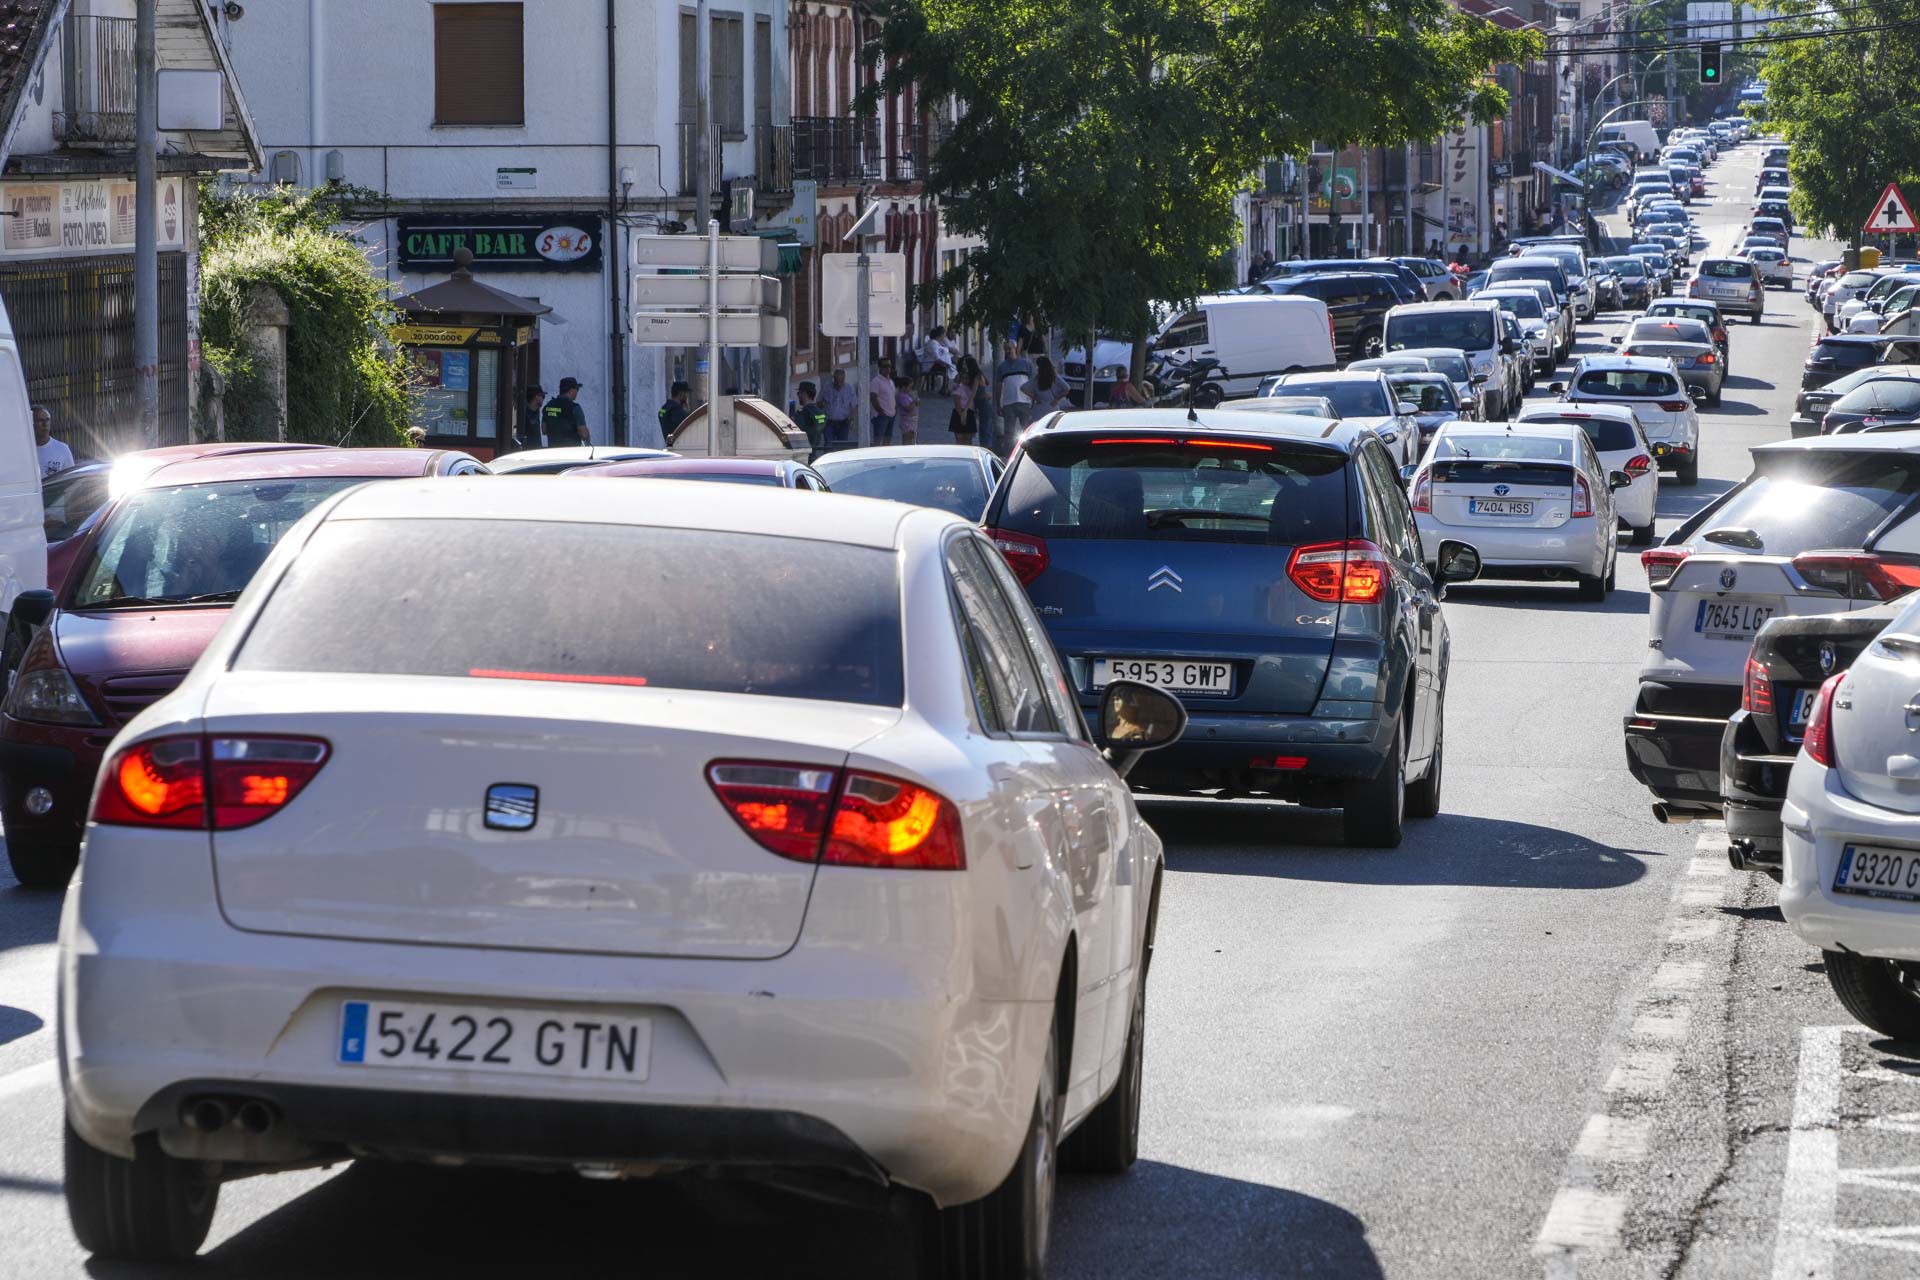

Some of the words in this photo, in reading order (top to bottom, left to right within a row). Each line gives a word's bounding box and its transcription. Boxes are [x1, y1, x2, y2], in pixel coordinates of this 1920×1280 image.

[33, 217, 52, 238] Kodak
[63, 221, 84, 247] FOTO
[85, 221, 107, 245] VIDEO
[406, 233, 467, 255] CAFE
[475, 232, 527, 255] BAR
[1476, 502, 1504, 513] 7404
[1509, 503, 1530, 514] HSS
[1295, 614, 1333, 625] C4
[1704, 604, 1740, 629] 7645
[1112, 661, 1175, 685] 5953
[1183, 664, 1227, 687] GWP
[1852, 852, 1903, 888] 9320
[378, 1011, 514, 1064] 5422
[535, 1020, 638, 1073] GTN
